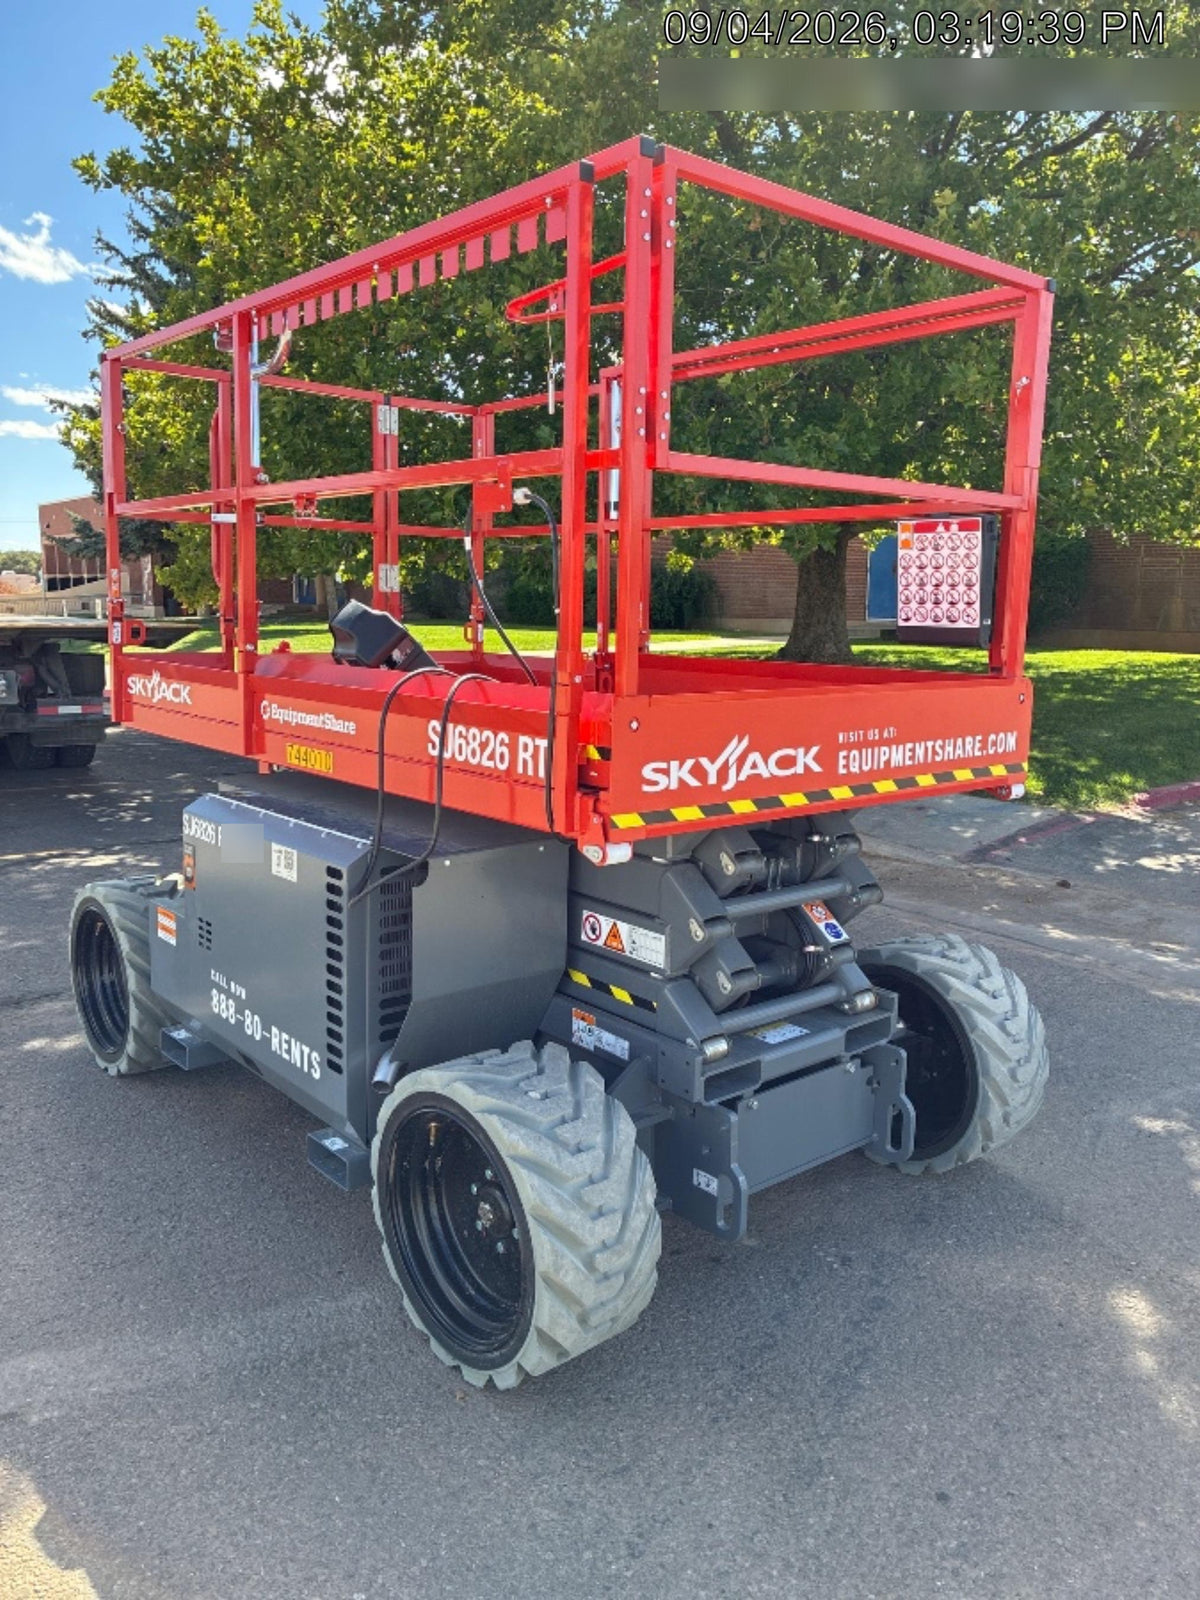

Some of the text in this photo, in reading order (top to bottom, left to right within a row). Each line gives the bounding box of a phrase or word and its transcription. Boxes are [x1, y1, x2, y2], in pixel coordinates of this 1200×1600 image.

[127, 669, 192, 704] SKYJACK
[271, 703, 356, 735] EquipmentShare
[867, 728, 879, 741] US
[427, 719, 549, 779] SJ6826 RT
[641, 734, 823, 792] SKYJACK
[838, 731, 1018, 774] EQUIPMENTSHARE.COM
[183, 813, 216, 845] SJ6826
[211, 987, 321, 1080] 888-80-RENTS
